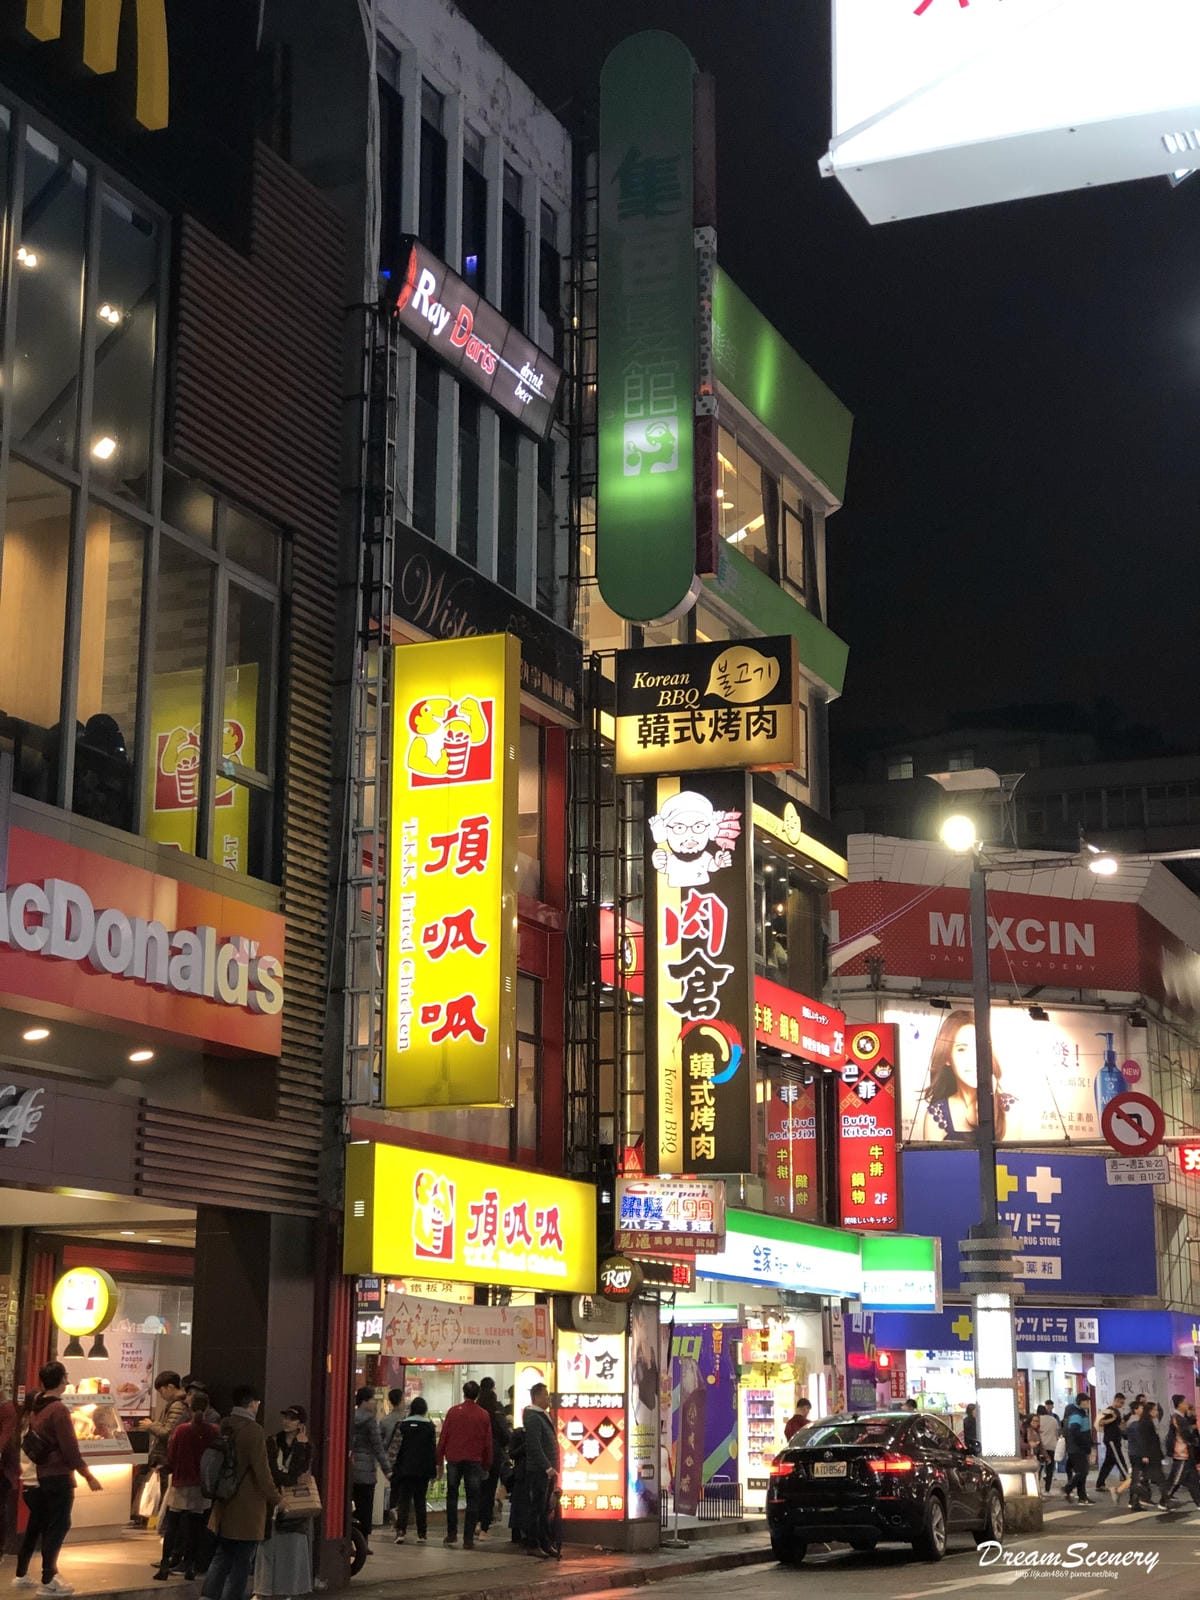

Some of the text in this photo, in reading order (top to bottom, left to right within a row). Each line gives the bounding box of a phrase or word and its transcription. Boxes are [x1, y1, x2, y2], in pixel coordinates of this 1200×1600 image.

[411, 268, 497, 375] Ray Darts
[514, 377, 533, 404] beer
[519, 362, 545, 391] drink
[632, 672, 690, 688] Korean
[717, 659, 772, 698] 불고기
[658, 688, 701, 709] BBQ
[637, 705, 778, 748] 韓式烤肉
[421, 815, 490, 1046] 頂呱呱
[928, 911, 1096, 957] MXCIN
[397, 959, 413, 1052] Chicken
[1122, 1067, 1139, 1077] NEW
[661, 1067, 678, 1154] Korean BBQ
[689, 1052, 716, 1160] 韓式烤肉
[842, 1115, 876, 1128] Buffy
[842, 1127, 893, 1138] Kitchen
[869, 1145, 884, 1177] 牛排
[679, 1190, 708, 1199] park
[851, 1172, 865, 1204] 鍋物
[874, 1193, 888, 1205] 2F
[467, 1191, 563, 1252] 頂呱呱
[666, 1199, 714, 1221] 499
[998, 1212, 1060, 1233] ツドラ
[1039, 1237, 1062, 1247] STORE
[600, 1269, 632, 1289] Ray
